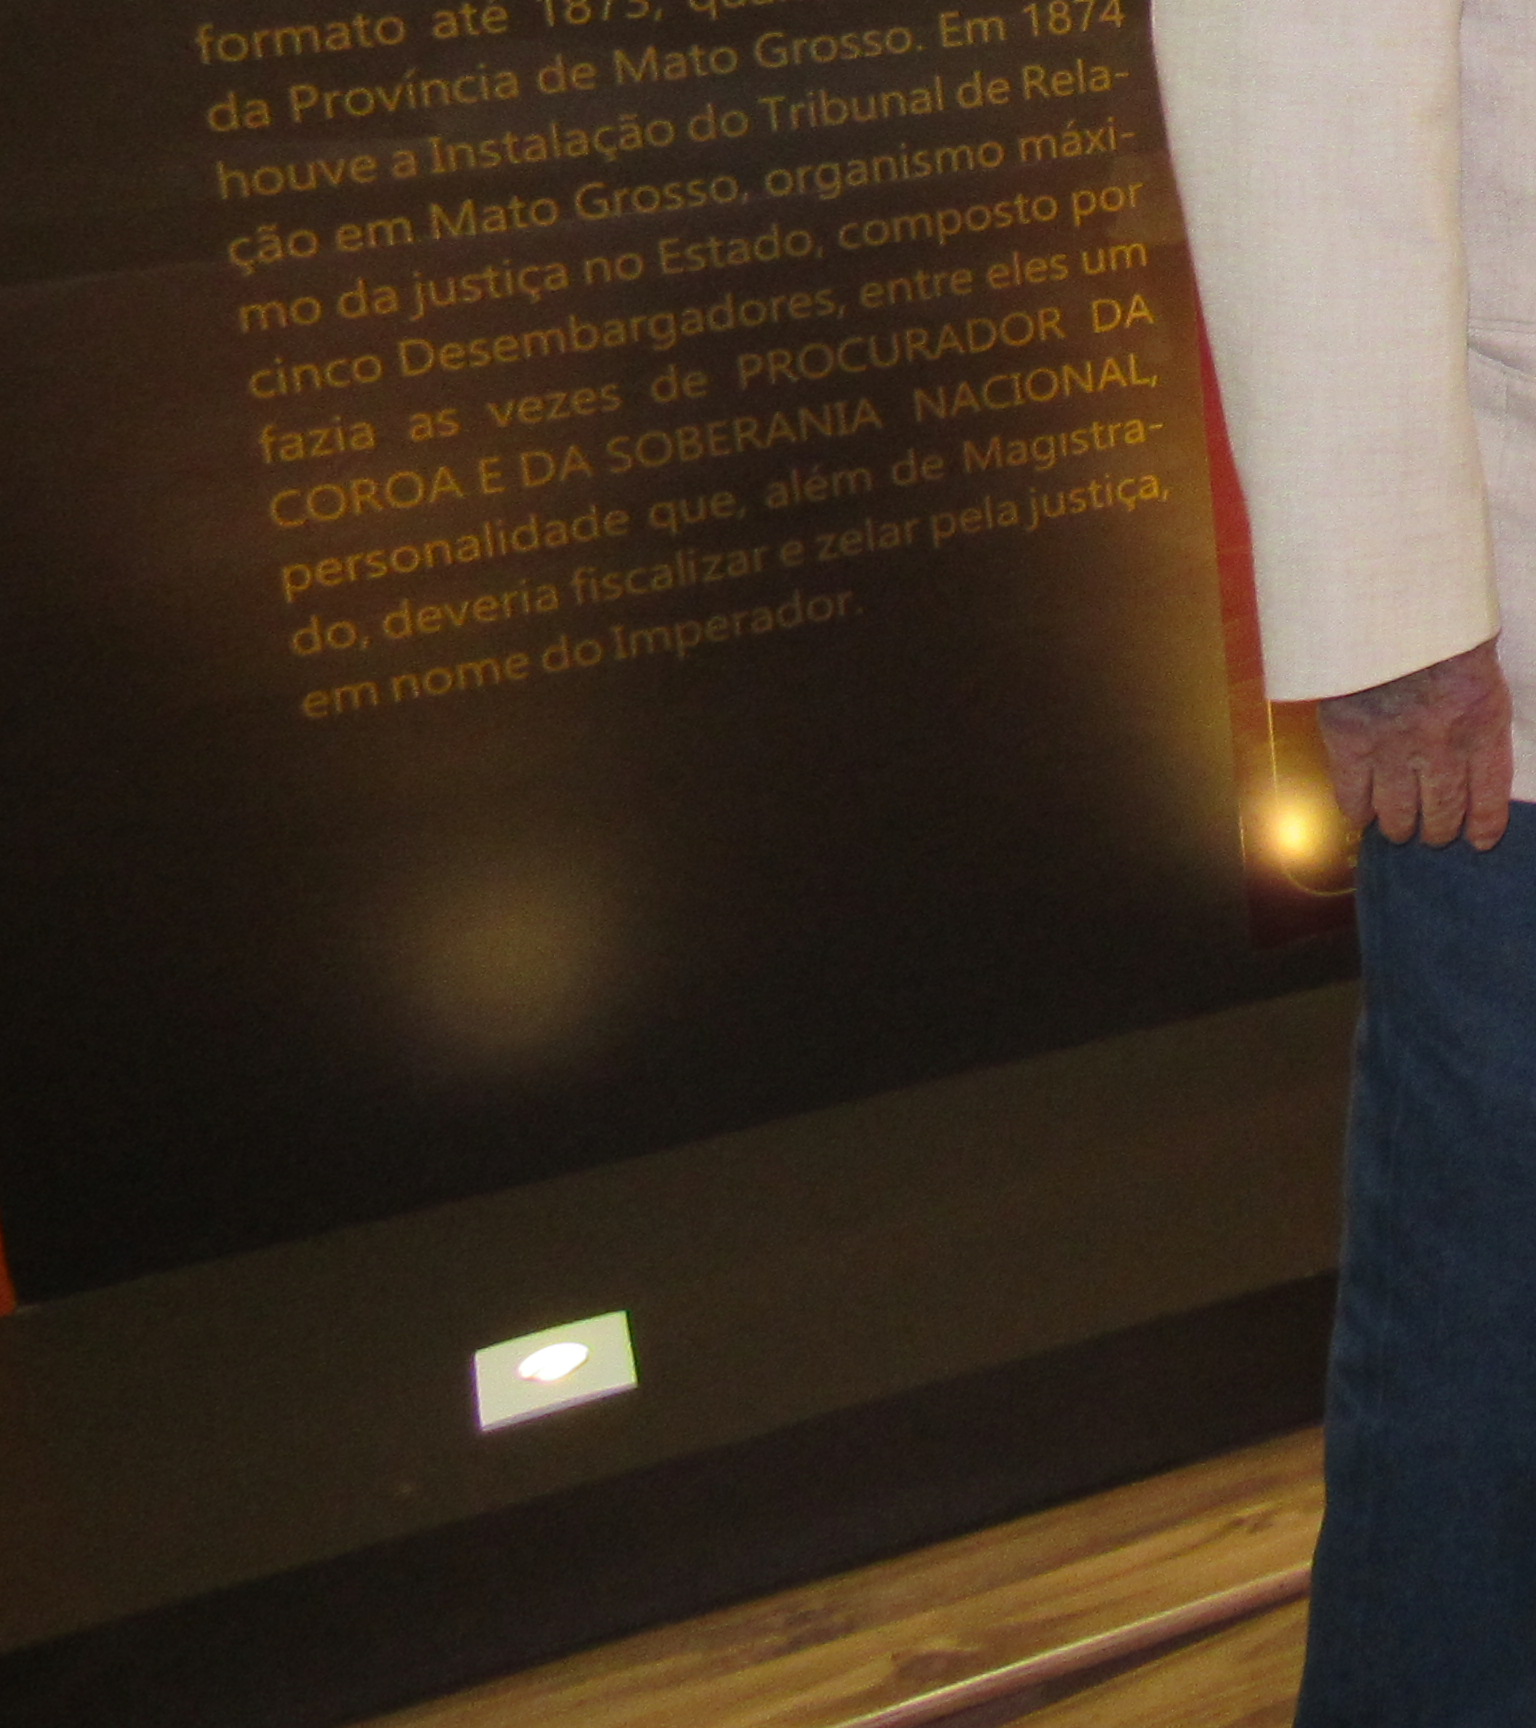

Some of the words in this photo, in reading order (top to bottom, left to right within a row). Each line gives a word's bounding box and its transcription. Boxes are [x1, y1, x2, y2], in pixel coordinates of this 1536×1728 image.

[196, 14, 406, 64] formato
[433, 3, 509, 40] até
[216, 154, 378, 200] houve
[392, 149, 418, 179] a
[428, 113, 675, 175] Instalação
[688, 103, 749, 142] do
[759, 75, 944, 132] Tribunal
[957, 70, 1010, 109] de
[1022, 58, 1129, 100] Rela-
[249, 354, 383, 399] cinco
[398, 288, 847, 377] Desembargadores,
[861, 269, 973, 308] entre
[987, 251, 1069, 289] eles
[1082, 240, 1148, 275] um
[269, 465, 464, 529] COROA
[478, 455, 506, 496] E
[520, 444, 592, 488] DA
[607, 398, 882, 474] SOBERANIA
[914, 353, 1159, 421] NACIONAL,
